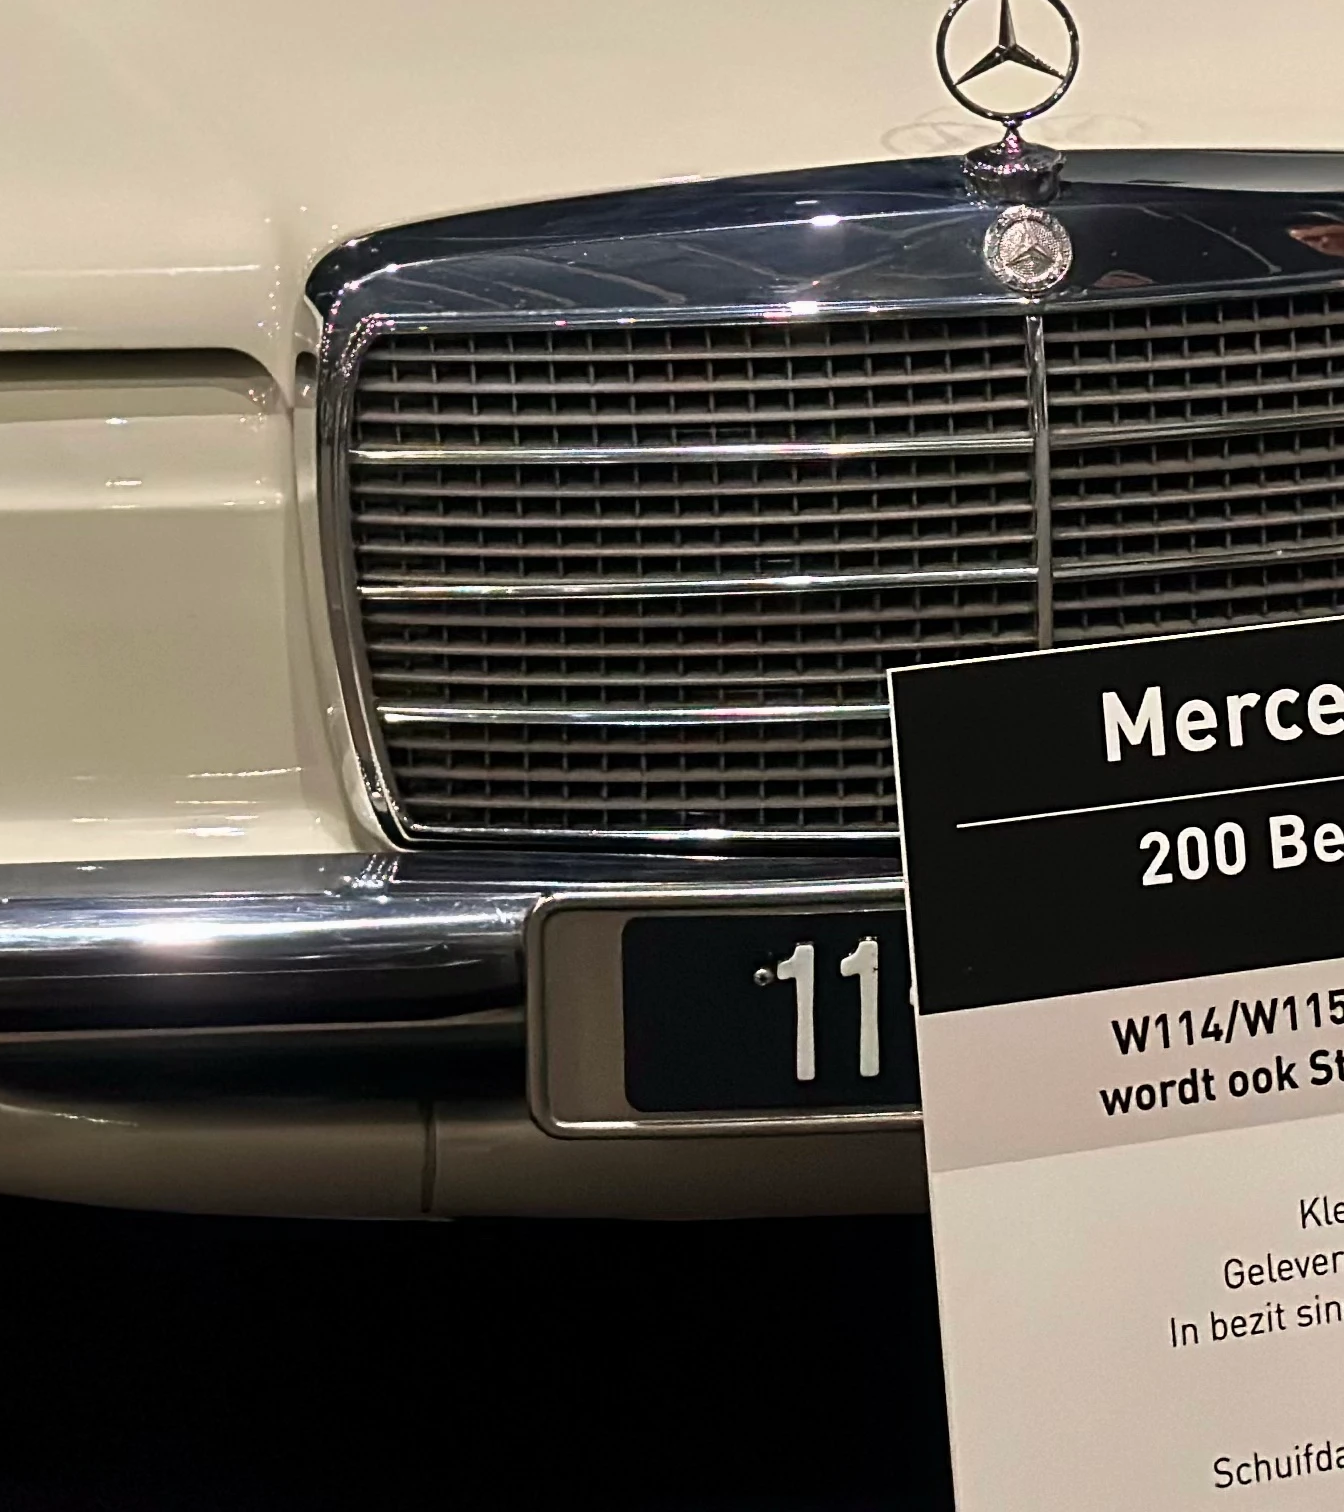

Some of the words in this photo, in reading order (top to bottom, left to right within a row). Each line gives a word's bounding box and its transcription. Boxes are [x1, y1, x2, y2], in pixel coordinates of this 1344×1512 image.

[1140, 821, 1247, 886] 200
[1099, 1067, 1217, 1116] wordt
[1228, 1055, 1300, 1098] ook
[1170, 1317, 1199, 1348] In
[1210, 1301, 1287, 1341] bezit
